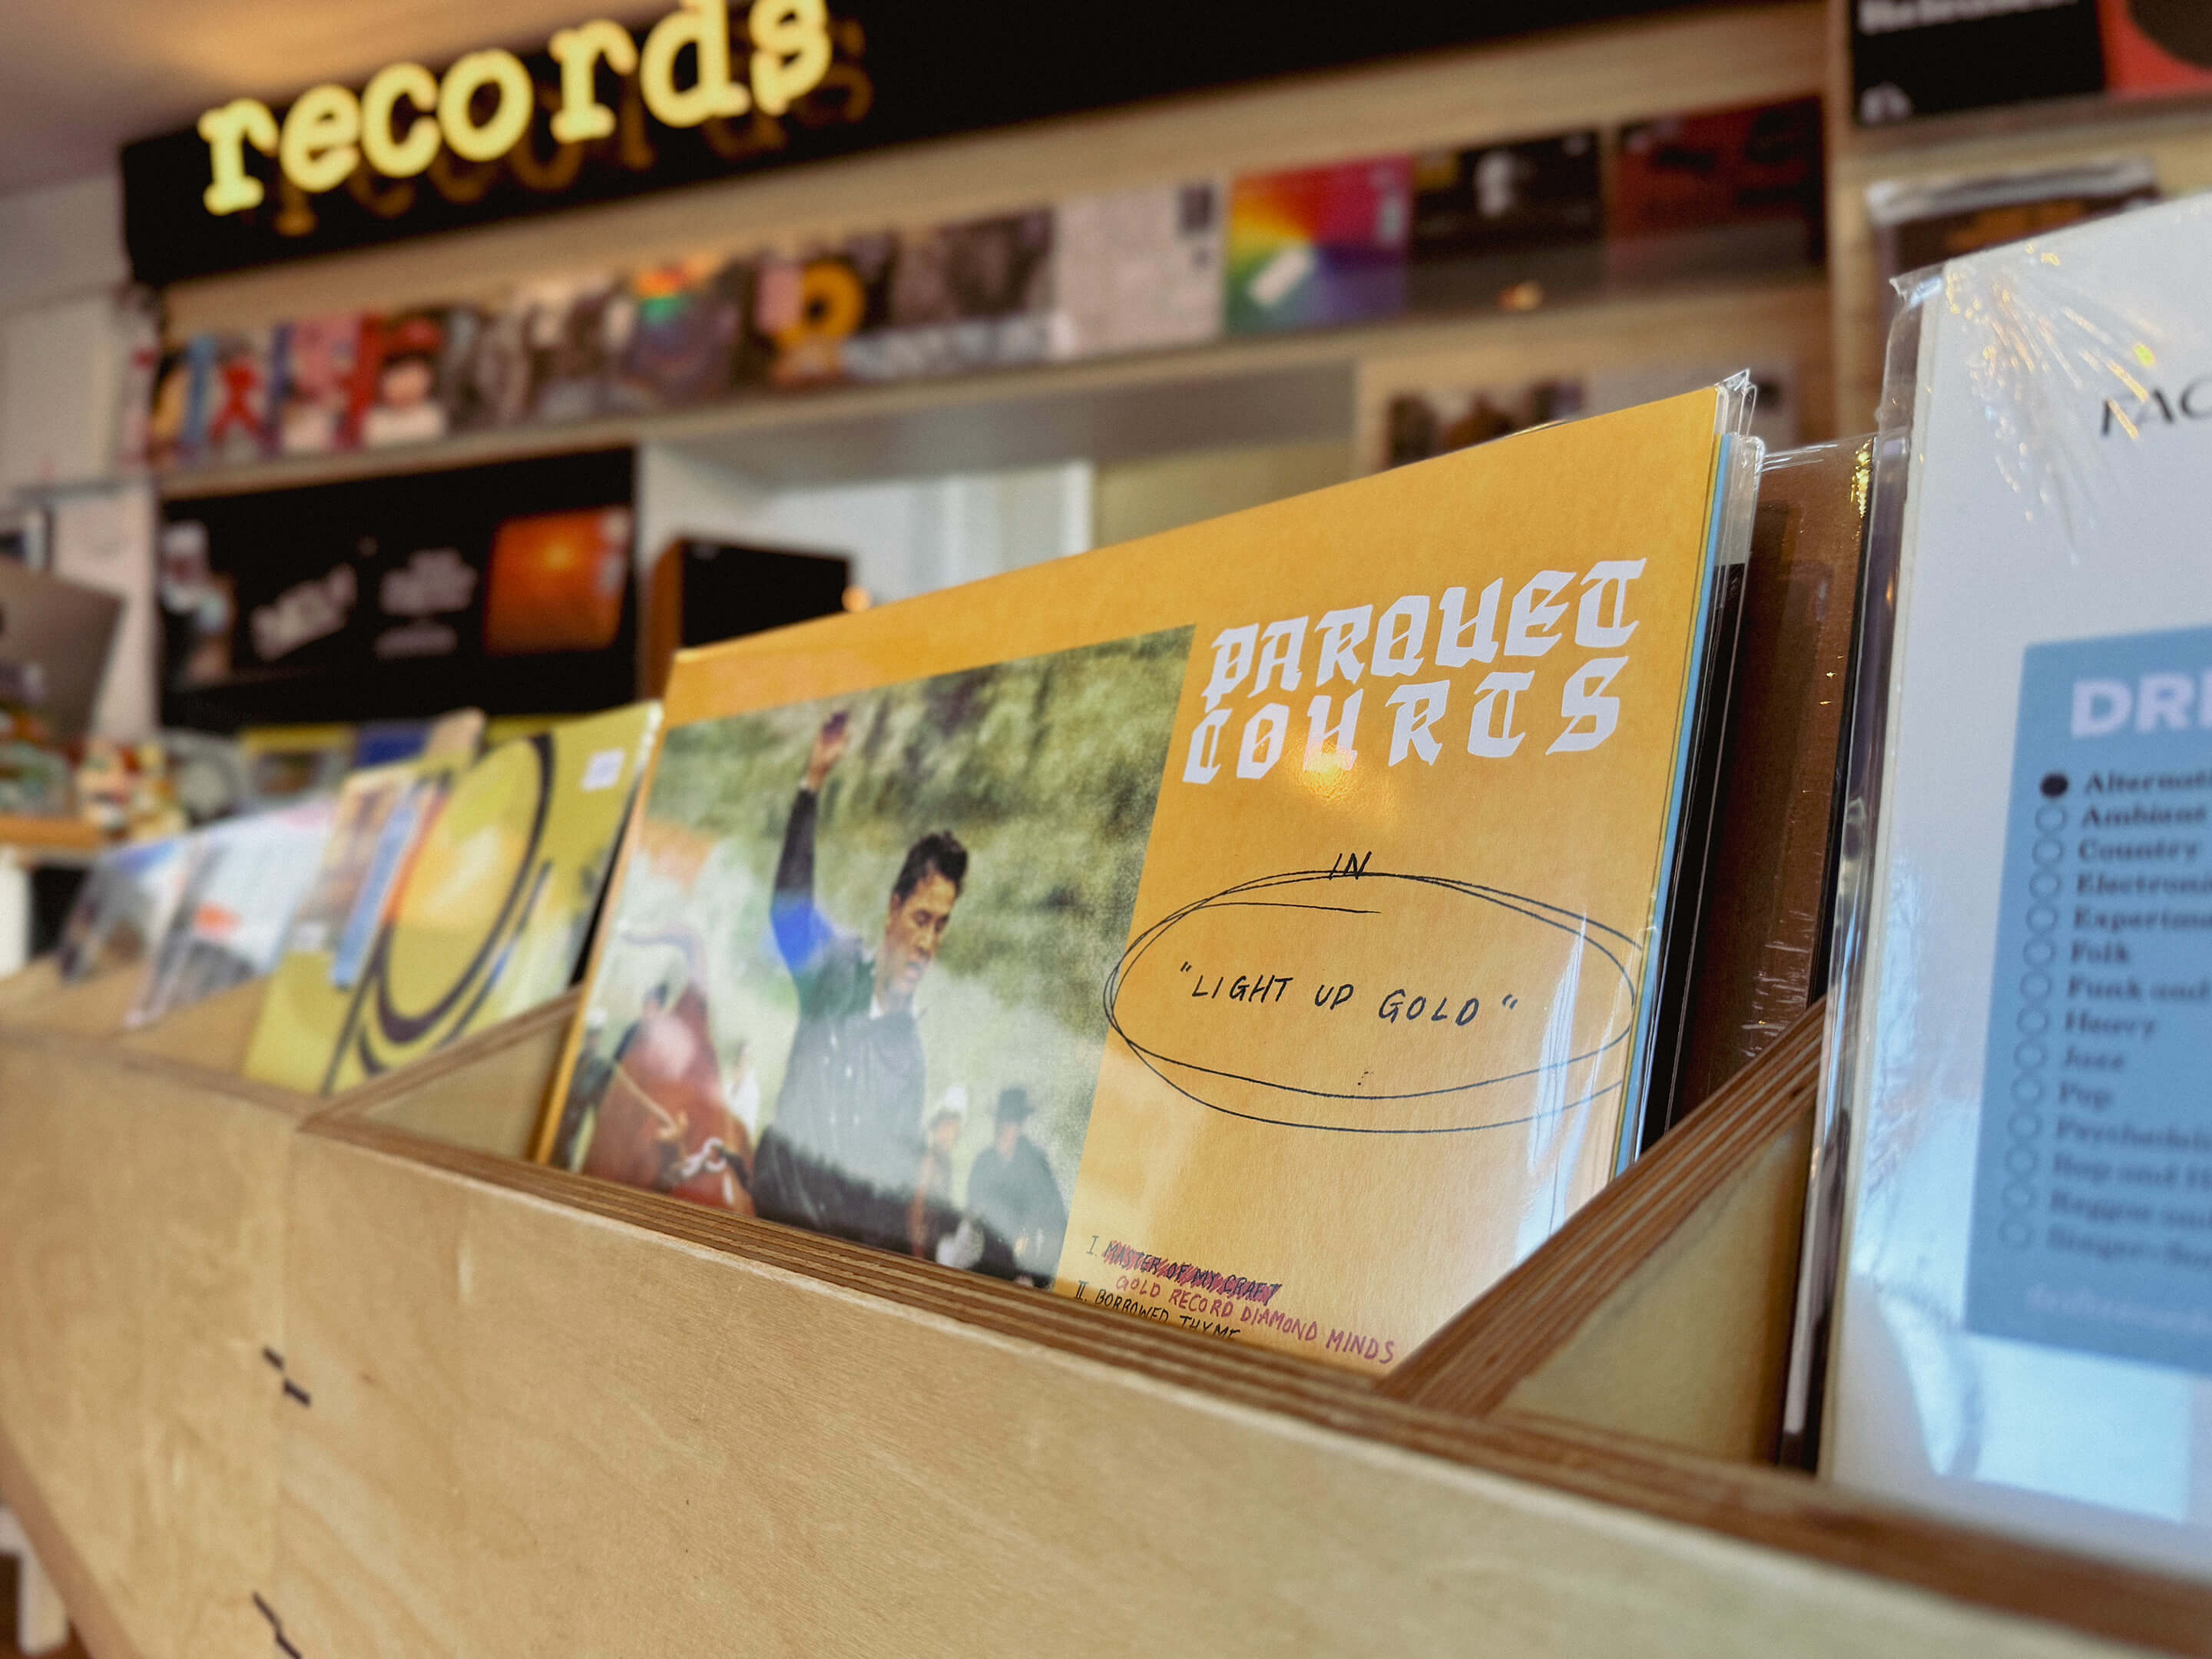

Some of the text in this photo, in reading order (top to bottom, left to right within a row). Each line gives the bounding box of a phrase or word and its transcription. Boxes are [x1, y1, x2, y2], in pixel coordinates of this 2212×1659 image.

[198, 0, 833, 216] records
[1200, 557, 1647, 714] PARQUET
[1182, 656, 1629, 784] COURTS
[2082, 804, 2207, 828] Ambient
[1330, 851, 1373, 880] IN
[2078, 839, 2197, 863] Country
[2071, 941, 2130, 965] Folk
[1314, 983, 1354, 1010] UP
[1116, 1275, 1395, 1364] GOLD RECORD DIAMOND MINDS
